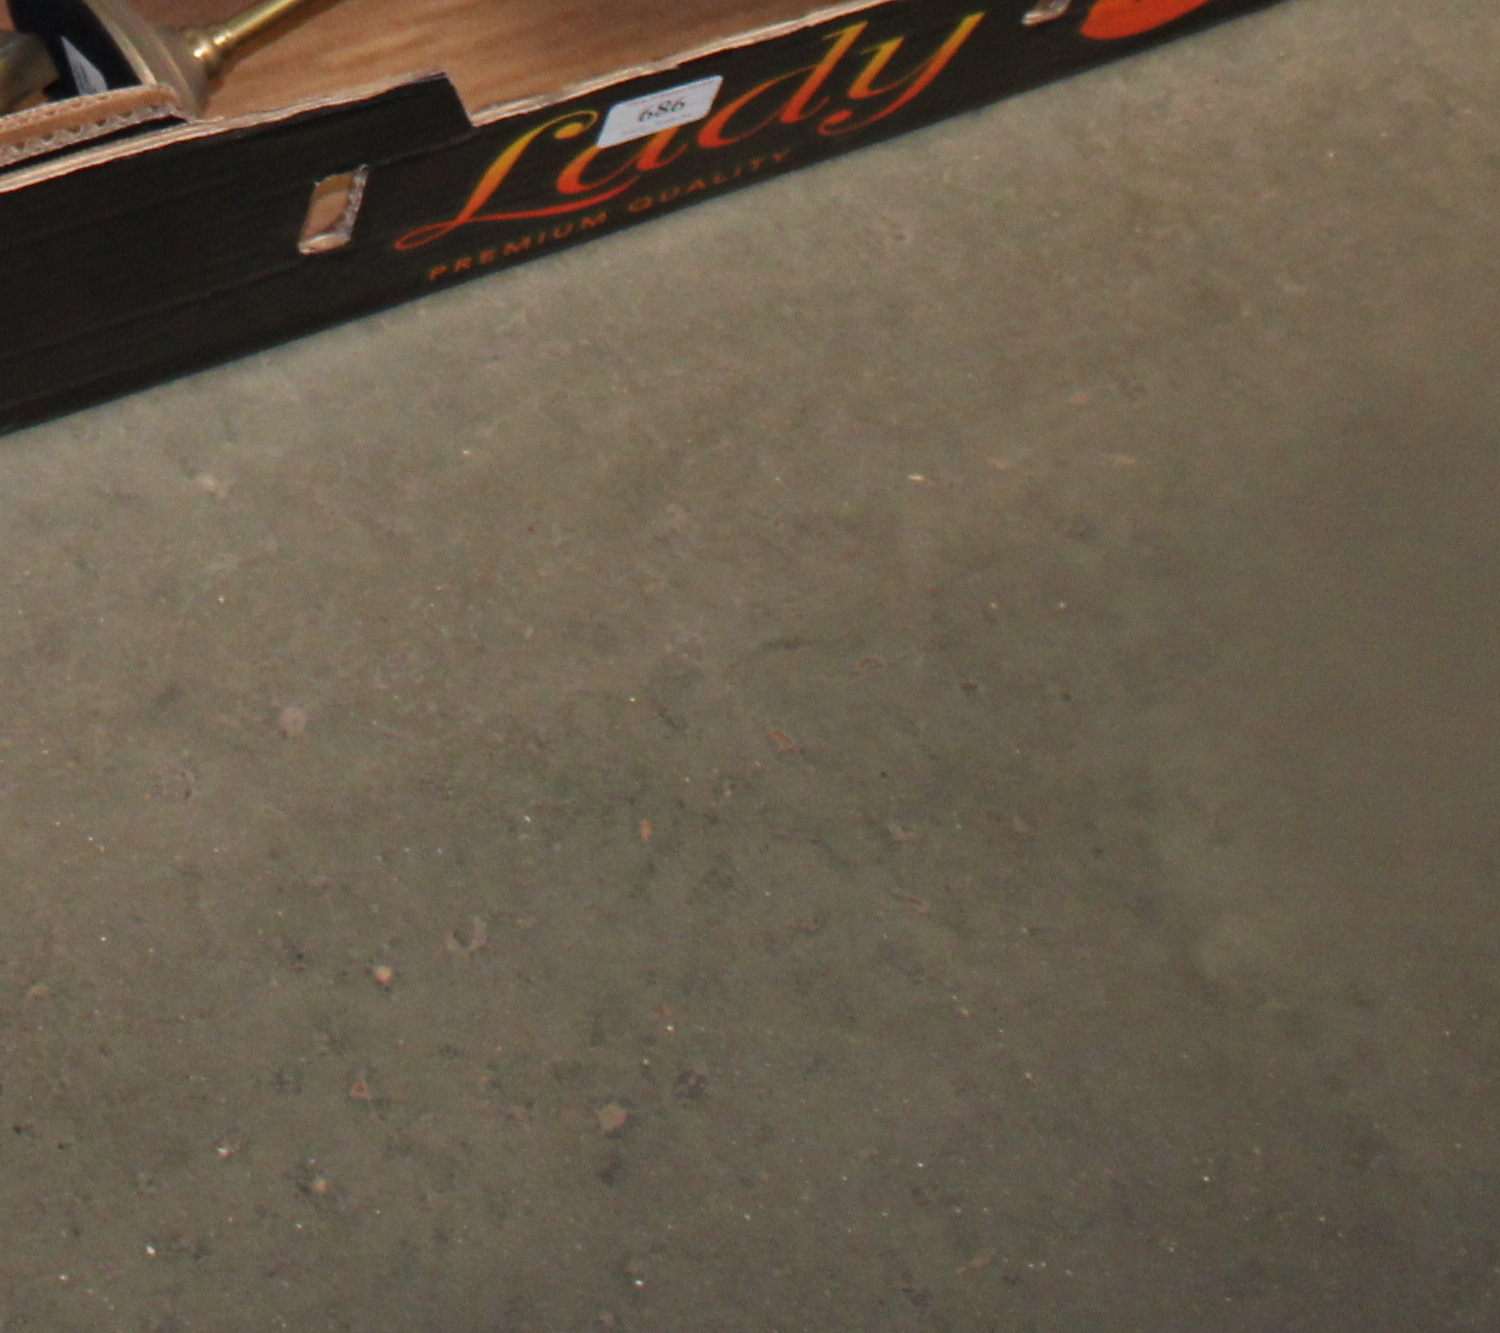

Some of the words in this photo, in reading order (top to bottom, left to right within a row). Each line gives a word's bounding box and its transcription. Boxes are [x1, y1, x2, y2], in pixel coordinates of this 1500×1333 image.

[393, 10, 987, 253] Lady
[427, 211, 610, 282] PREMIUM
[628, 149, 792, 215] QUALITY
